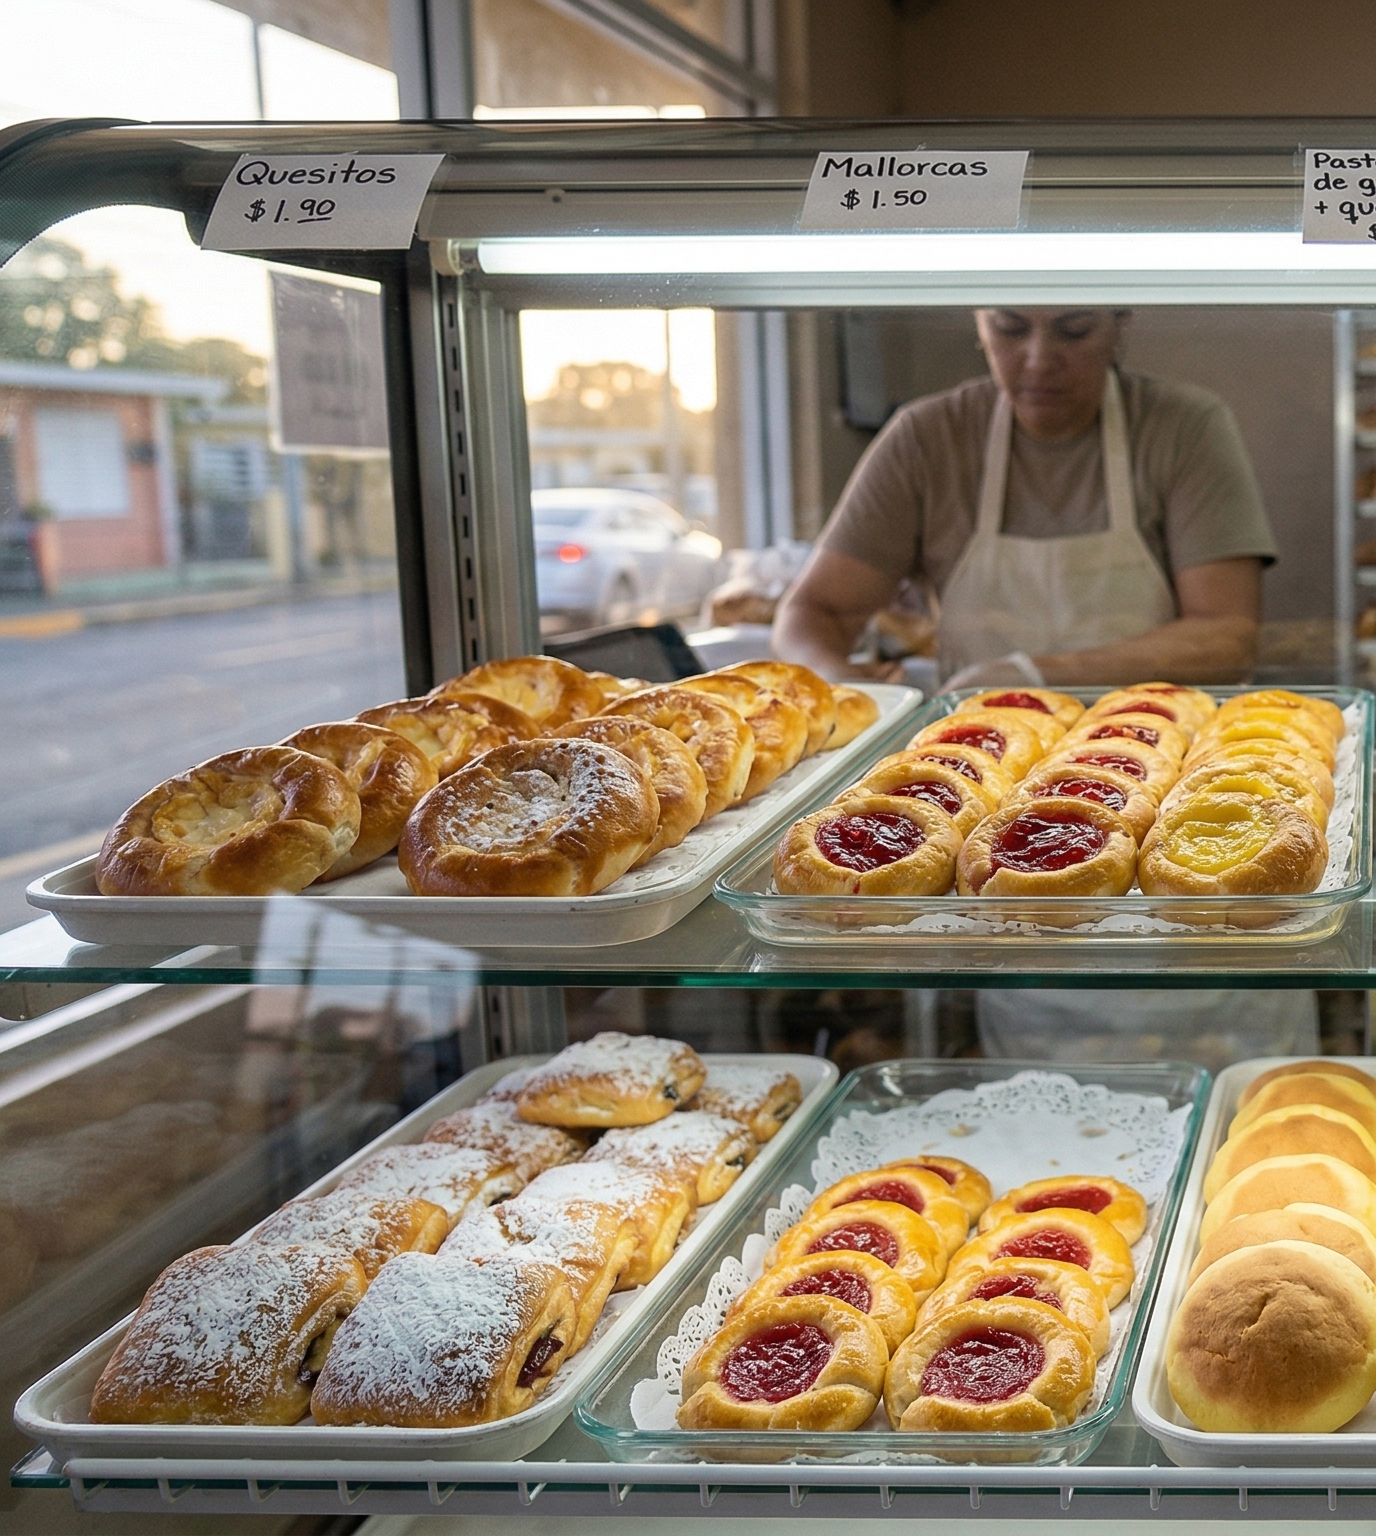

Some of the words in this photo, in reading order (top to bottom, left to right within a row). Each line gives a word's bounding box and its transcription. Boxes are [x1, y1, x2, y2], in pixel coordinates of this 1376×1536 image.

[236, 159, 396, 186] Quesitos
[821, 156, 988, 178] Mallorcas
[1313, 172, 1349, 191] de
[1314, 200, 1329, 215] +
